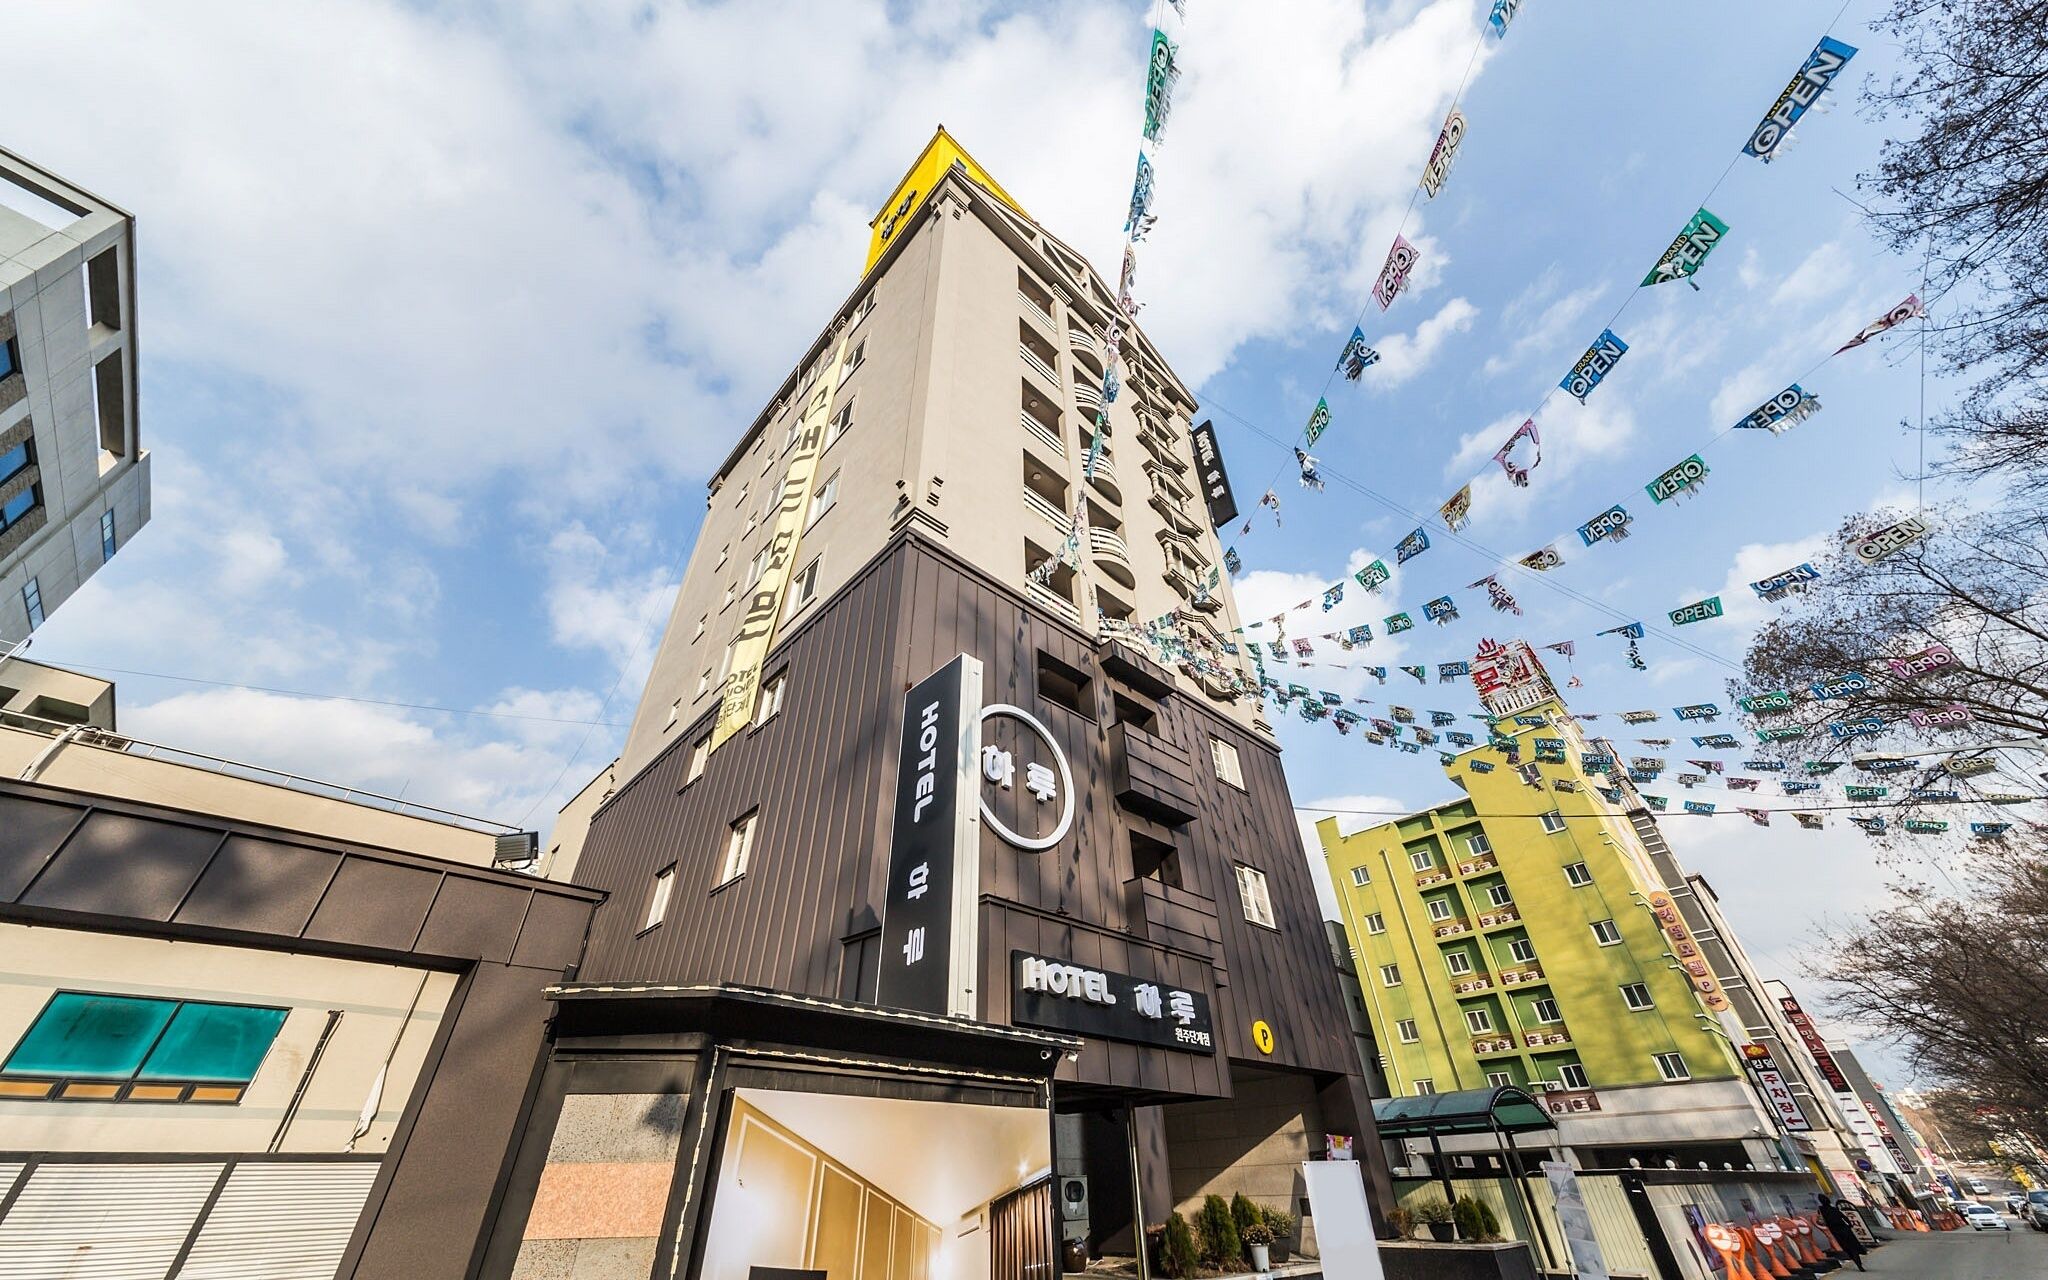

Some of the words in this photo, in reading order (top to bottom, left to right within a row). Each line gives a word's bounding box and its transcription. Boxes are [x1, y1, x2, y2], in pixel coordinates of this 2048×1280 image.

[1752, 50, 1847, 155] OPEN
[1569, 340, 1624, 399] OPEN
[1574, 347, 1597, 375] GRAND
[1398, 535, 1426, 562] OPEN
[1857, 517, 1926, 559] OPEN
[1672, 602, 1716, 624] OPEN
[913, 701, 940, 824] HOTEL
[1583, 754, 1611, 763] OPEN
[1951, 757, 1996, 770] OPEN
[1629, 769, 1655, 778] OPEN
[1848, 788, 1883, 796] OPEN
[1022, 956, 1118, 1006] HOTEL
[1134, 981, 1196, 1025] 하루
[1175, 1027, 1212, 1047] 원주단계점
[1261, 1028, 1270, 1047] P
[1751, 1058, 1776, 1070] 킹덤
[1763, 1073, 1795, 1114] 주차장
